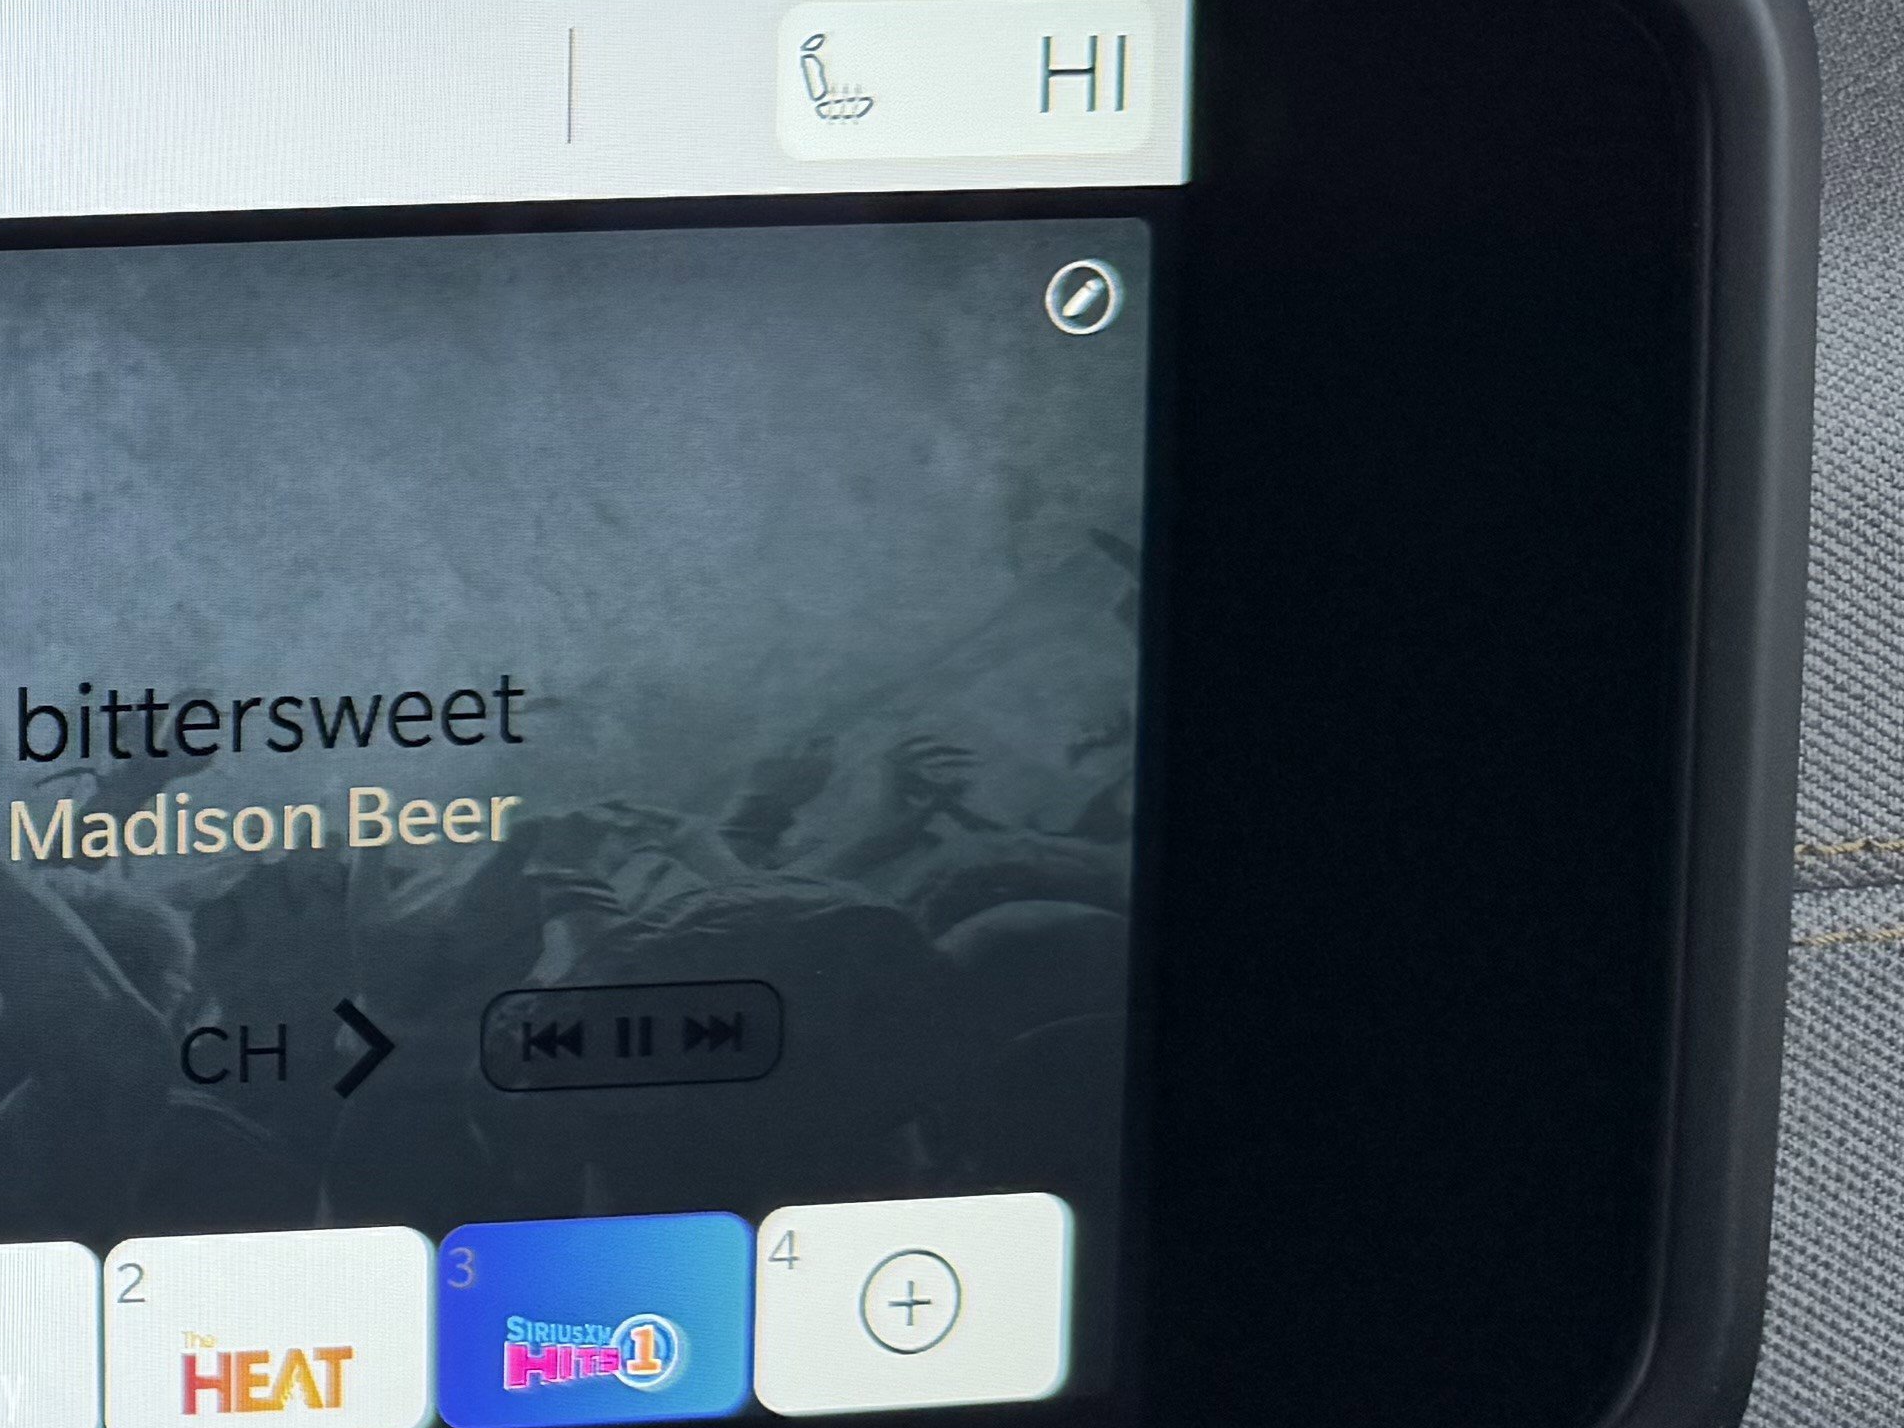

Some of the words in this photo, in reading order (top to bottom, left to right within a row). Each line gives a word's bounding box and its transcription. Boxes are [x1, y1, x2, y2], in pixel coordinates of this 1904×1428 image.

[1039, 33, 1129, 115] HI
[18, 675, 525, 762] bittersweet
[10, 793, 325, 861] Madison
[348, 787, 522, 847] Beer
[180, 1023, 287, 1085] CH
[447, 1247, 476, 1290] 3
[768, 1230, 800, 1270] 4
[116, 1263, 146, 1304] 2
[181, 1345, 354, 1415] HEAT
